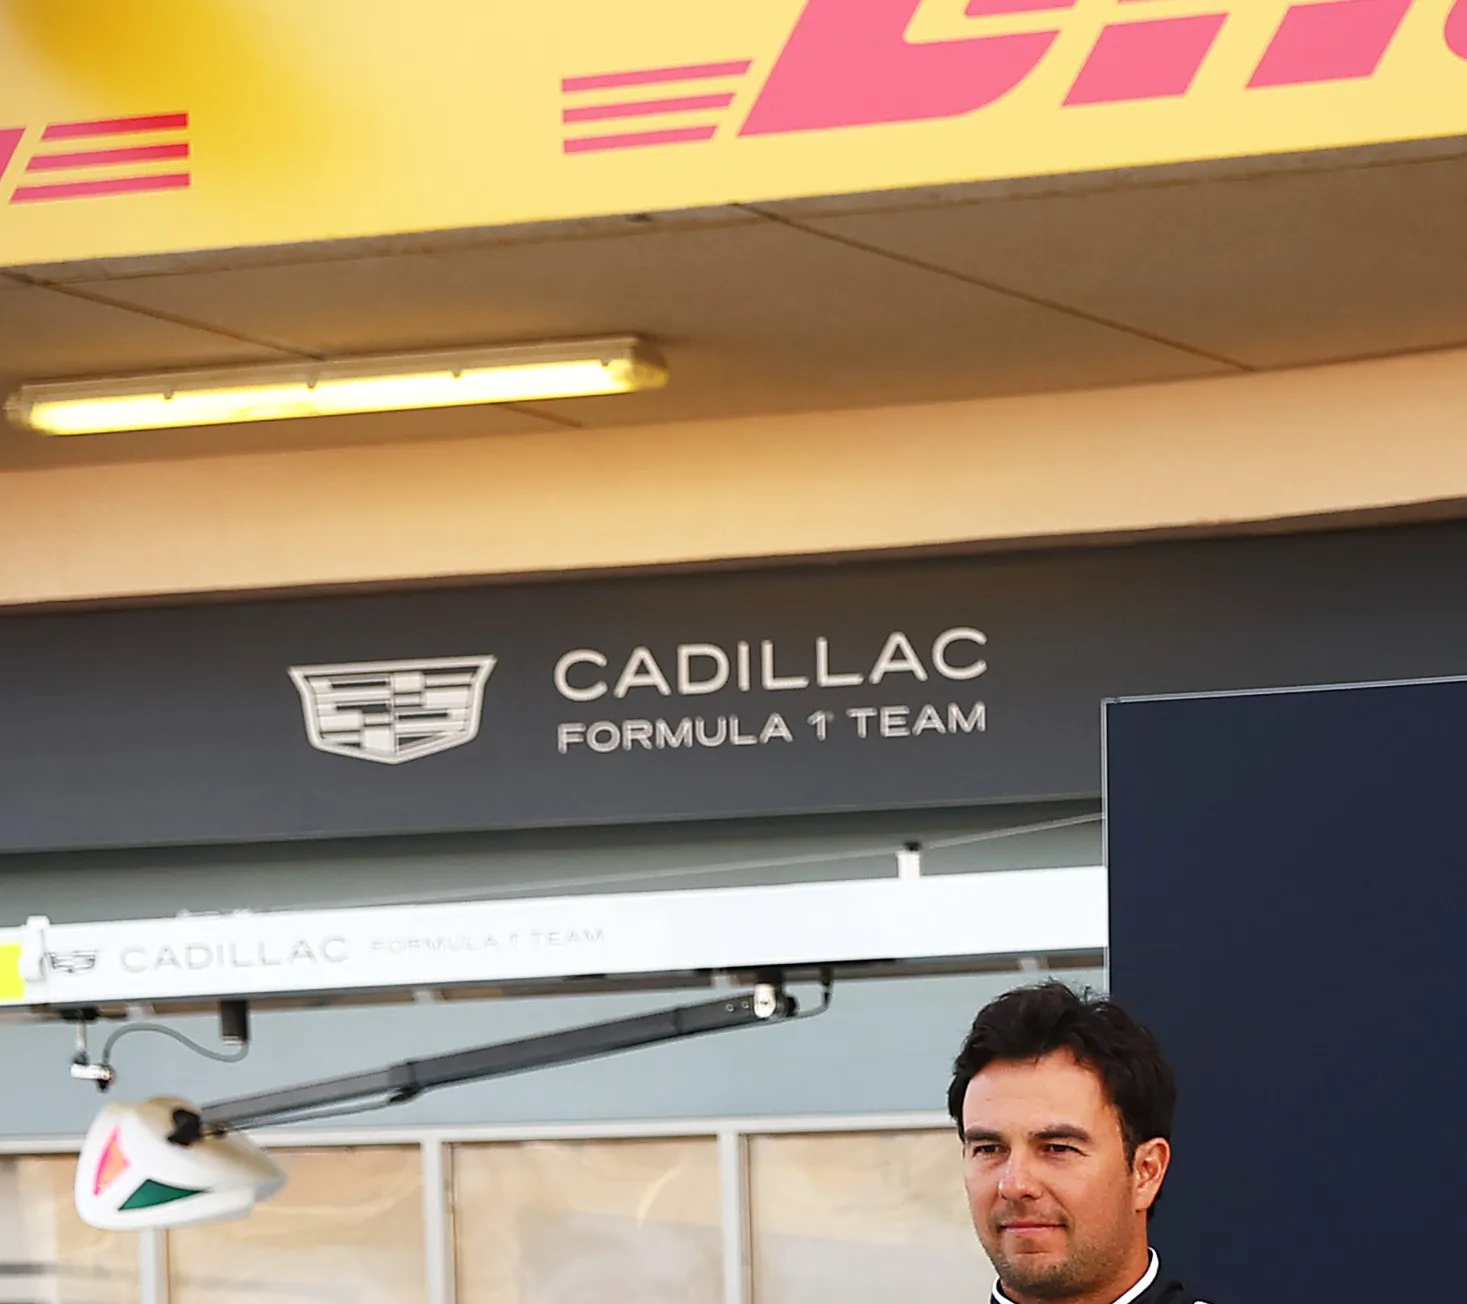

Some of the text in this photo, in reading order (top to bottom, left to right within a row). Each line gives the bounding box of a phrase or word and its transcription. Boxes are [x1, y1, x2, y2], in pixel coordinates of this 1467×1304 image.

[553, 627, 988, 701] CADILLAC
[557, 711, 792, 754] FORMULA
[847, 702, 987, 738] TEAM
[121, 936, 349, 975] CADILLAC
[372, 931, 502, 956] FORMULA
[531, 927, 604, 947] TEAM
